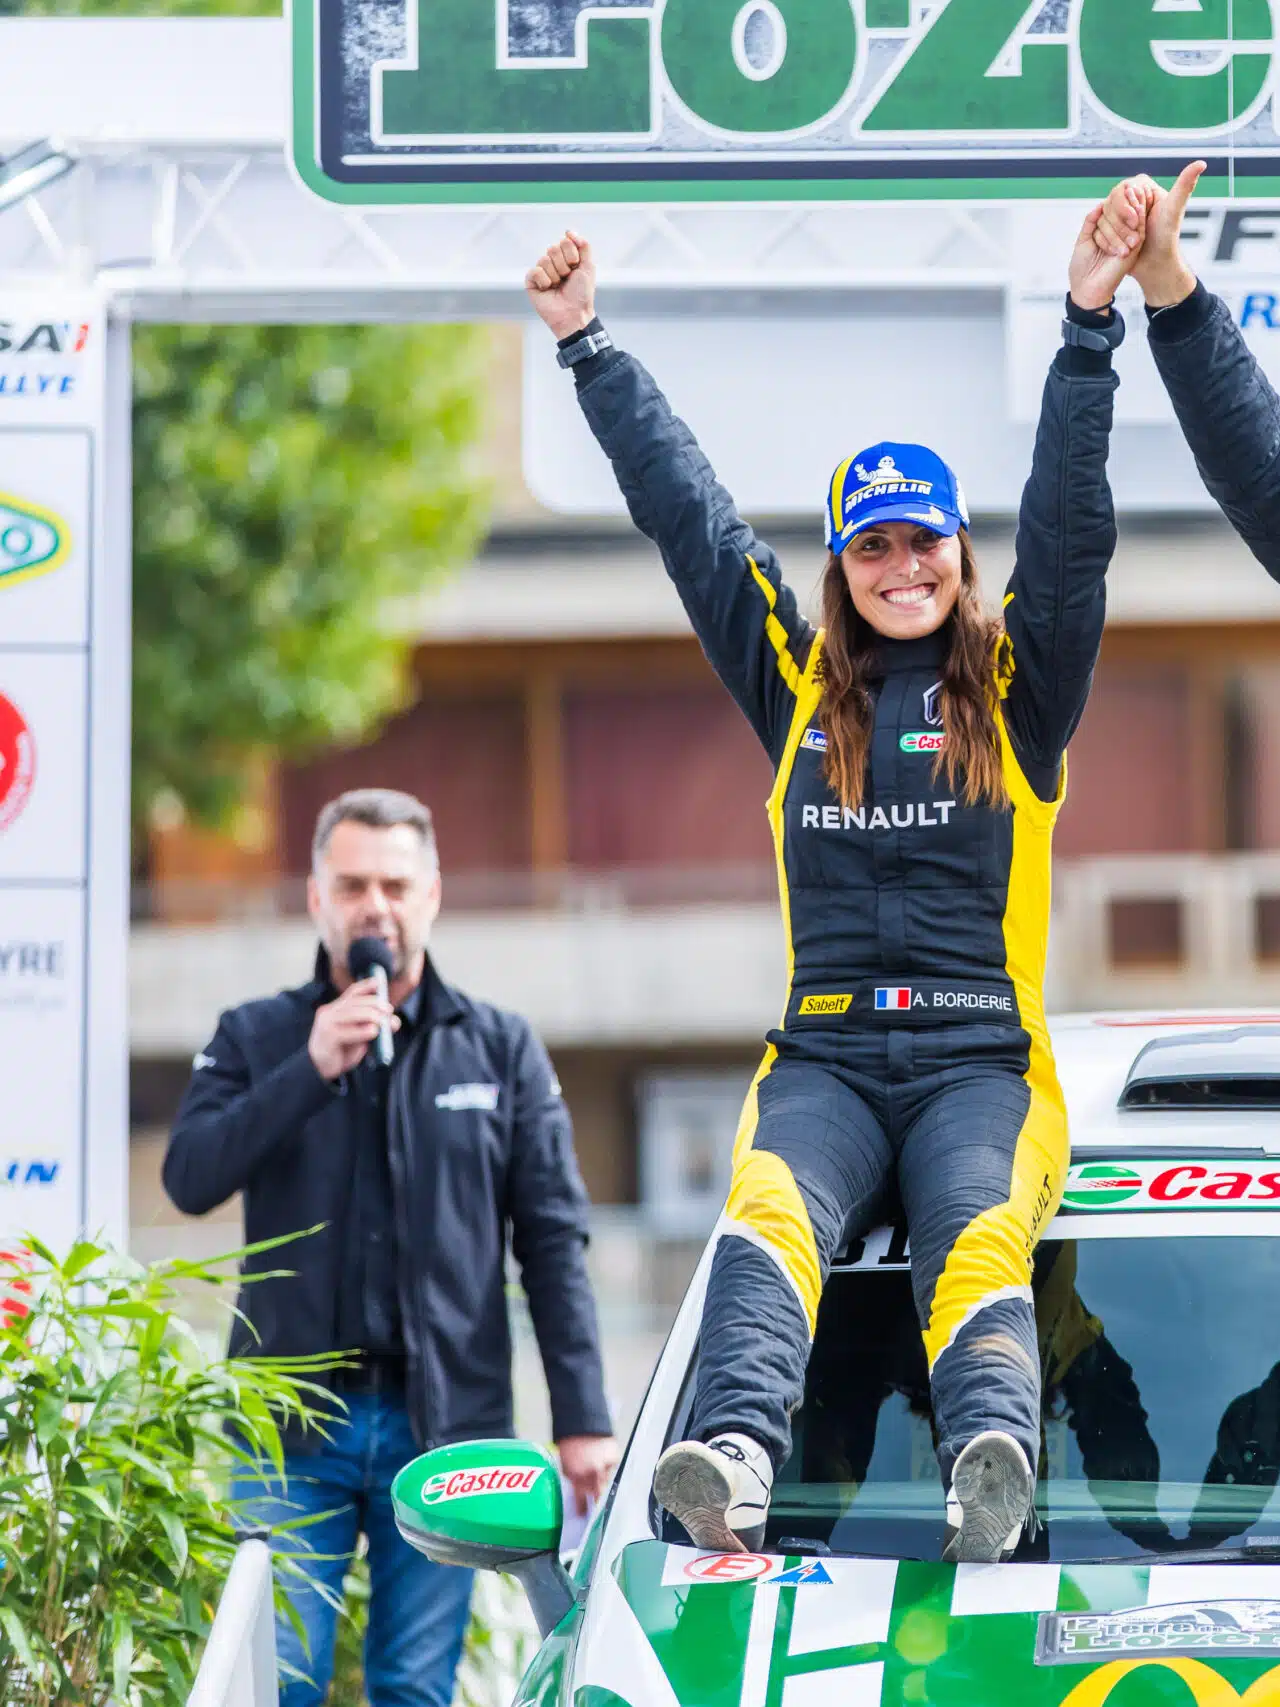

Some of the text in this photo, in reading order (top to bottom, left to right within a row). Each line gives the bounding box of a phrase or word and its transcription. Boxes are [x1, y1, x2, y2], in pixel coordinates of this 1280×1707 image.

[845, 483, 932, 513] MICHELIN
[918, 735, 945, 749] Cas
[802, 800, 956, 829] RENAULT
[805, 995, 846, 1013] Sabelt
[913, 992, 1012, 1012] A. BORDERIE
[446, 1469, 536, 1496] Castrol
[702, 1556, 748, 1577] E
